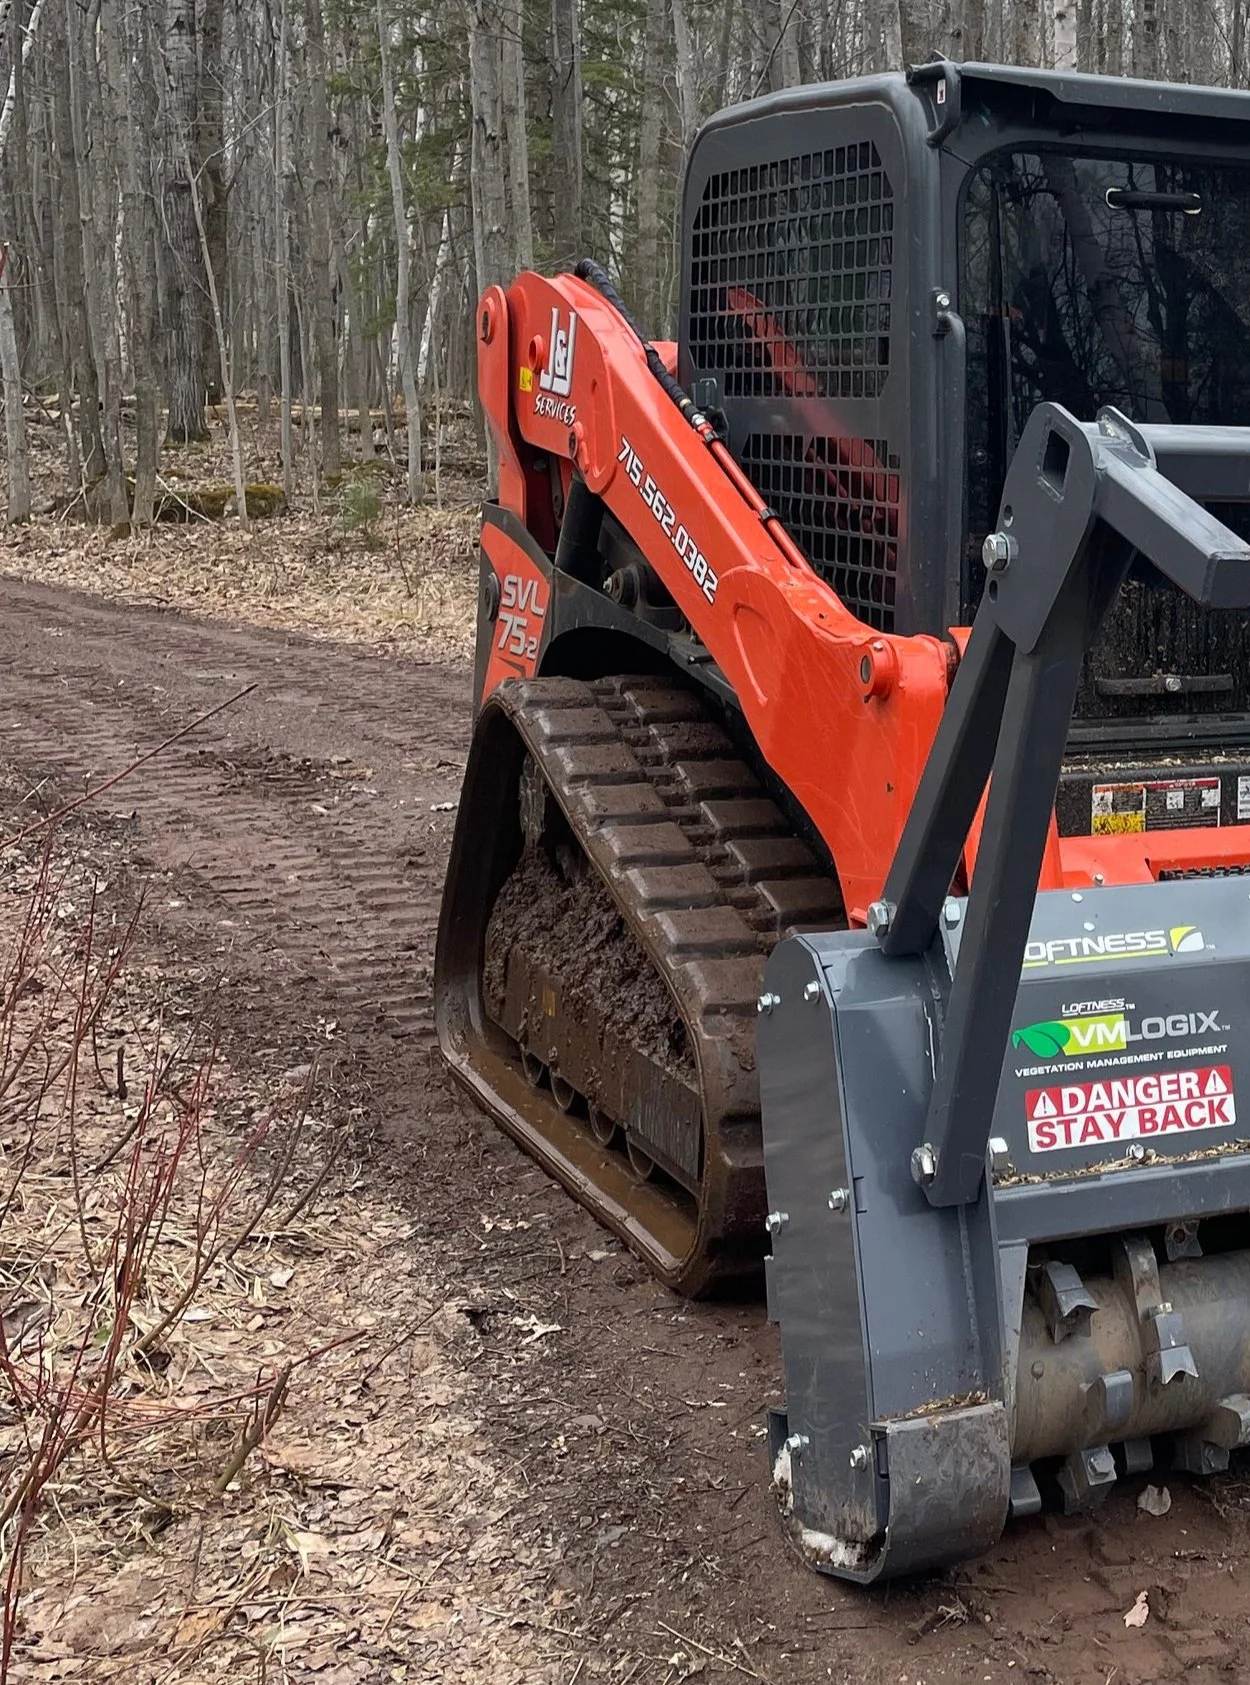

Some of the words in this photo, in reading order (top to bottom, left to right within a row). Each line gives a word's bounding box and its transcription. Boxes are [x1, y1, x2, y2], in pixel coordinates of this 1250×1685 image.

[533, 393, 577, 427] SERVICES
[617, 437, 719, 604] 715.562.0382
[501, 574, 545, 617] SVL
[1024, 930, 1165, 961] OFTNESS
[1062, 999, 1125, 1015] LOFTNESS
[1015, 1062, 1084, 1078] VEGETATION
[1086, 1052, 1165, 1069] MANAGEMENT
[1167, 1045, 1227, 1059] EQUIPMENT
[1061, 1071, 1200, 1113] DANGER
[1036, 1111, 1126, 1149] STAY
[1138, 1098, 1229, 1134] BACK
